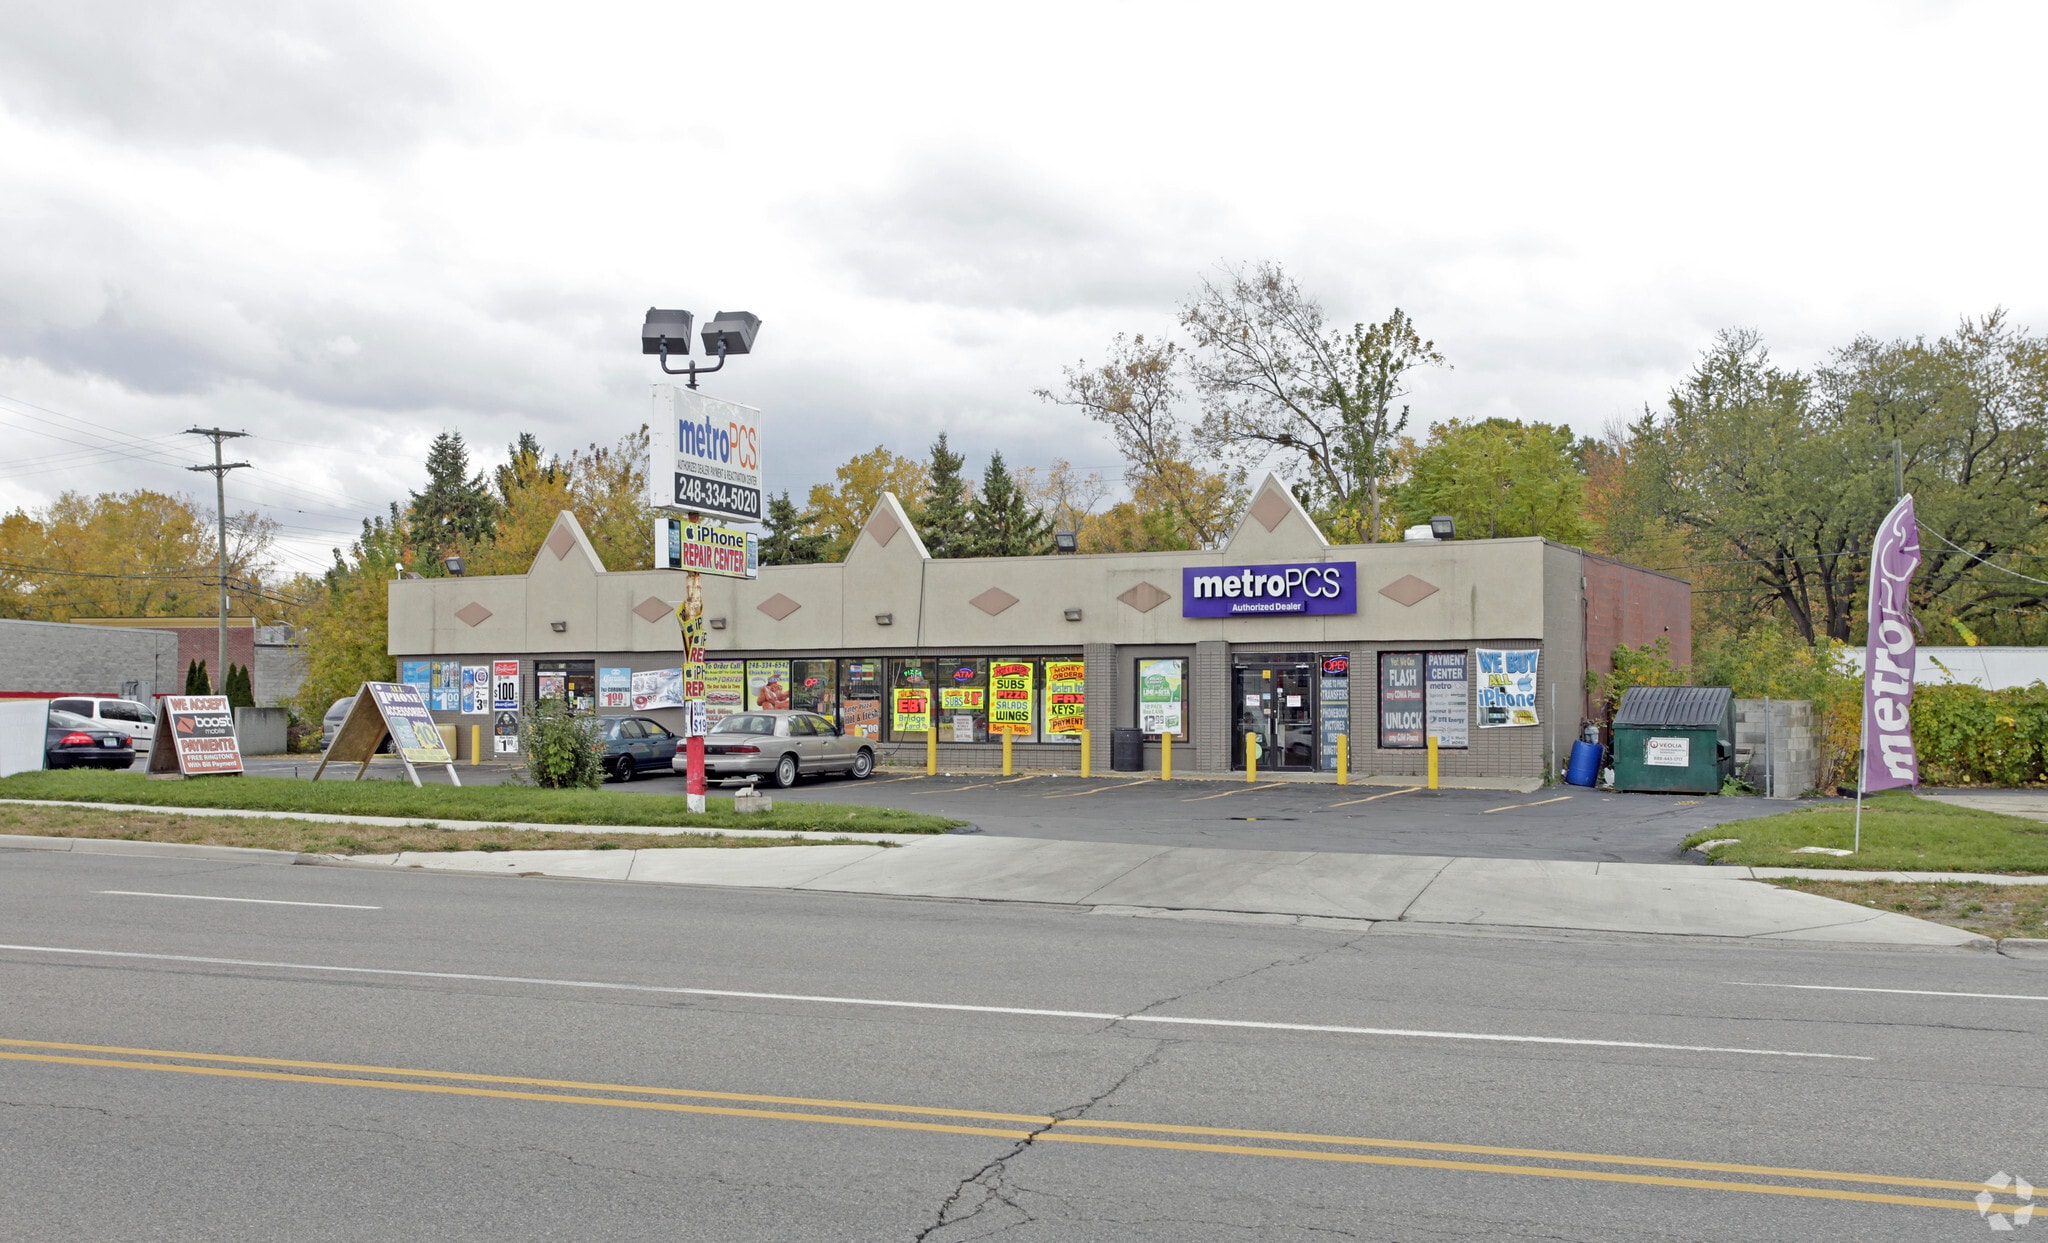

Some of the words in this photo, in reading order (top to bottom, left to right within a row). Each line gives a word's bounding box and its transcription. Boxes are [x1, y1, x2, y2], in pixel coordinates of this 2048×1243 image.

[679, 416, 757, 470] metroPCS
[677, 459, 697, 473] AUTHORIZED
[679, 477, 757, 514] 248-334-5020
[697, 525, 744, 548] iPhone
[683, 543, 712, 569] REPAIR
[714, 547, 744, 573] CENTER
[1194, 567, 1340, 598] metroPCS
[1232, 603, 1275, 613] Authorized
[1275, 602, 1302, 611] Dealer
[1429, 654, 1465, 666] PAYMENT
[1478, 651, 1504, 674] WE
[1506, 651, 1538, 674] BUY
[903, 668, 922, 677] PIZZA
[953, 670, 975, 679] ATM
[1054, 665, 1080, 674] MONEY
[1431, 668, 1464, 680] CENTER
[996, 679, 1025, 689] SUBS
[1389, 669, 1417, 687] FLASH
[1489, 674, 1513, 686] ALL
[997, 690, 1028, 700] PIZZA
[1052, 693, 1085, 704] FAX
[1321, 689, 1348, 700] TRANSFERS
[1478, 688, 1535, 707] iPhone
[170, 698, 188, 711] WE
[190, 698, 227, 711] ACCEPT
[897, 698, 927, 714] EBT
[945, 697, 963, 706] SUBS
[996, 701, 1028, 710] SALADS
[1052, 704, 1075, 715] KEYS
[194, 715, 232, 728] boost
[898, 714, 926, 723] Bridge
[996, 711, 1029, 721] WINGS
[1385, 711, 1422, 730] UNLOCK
[1052, 717, 1083, 730] PAYMENT
[1325, 720, 1345, 731] PICTURES
[181, 737, 236, 752] PAYMENTS
[187, 753, 203, 761] FREE
[204, 753, 235, 761] RINGTONE
[212, 760, 237, 768] Payment
